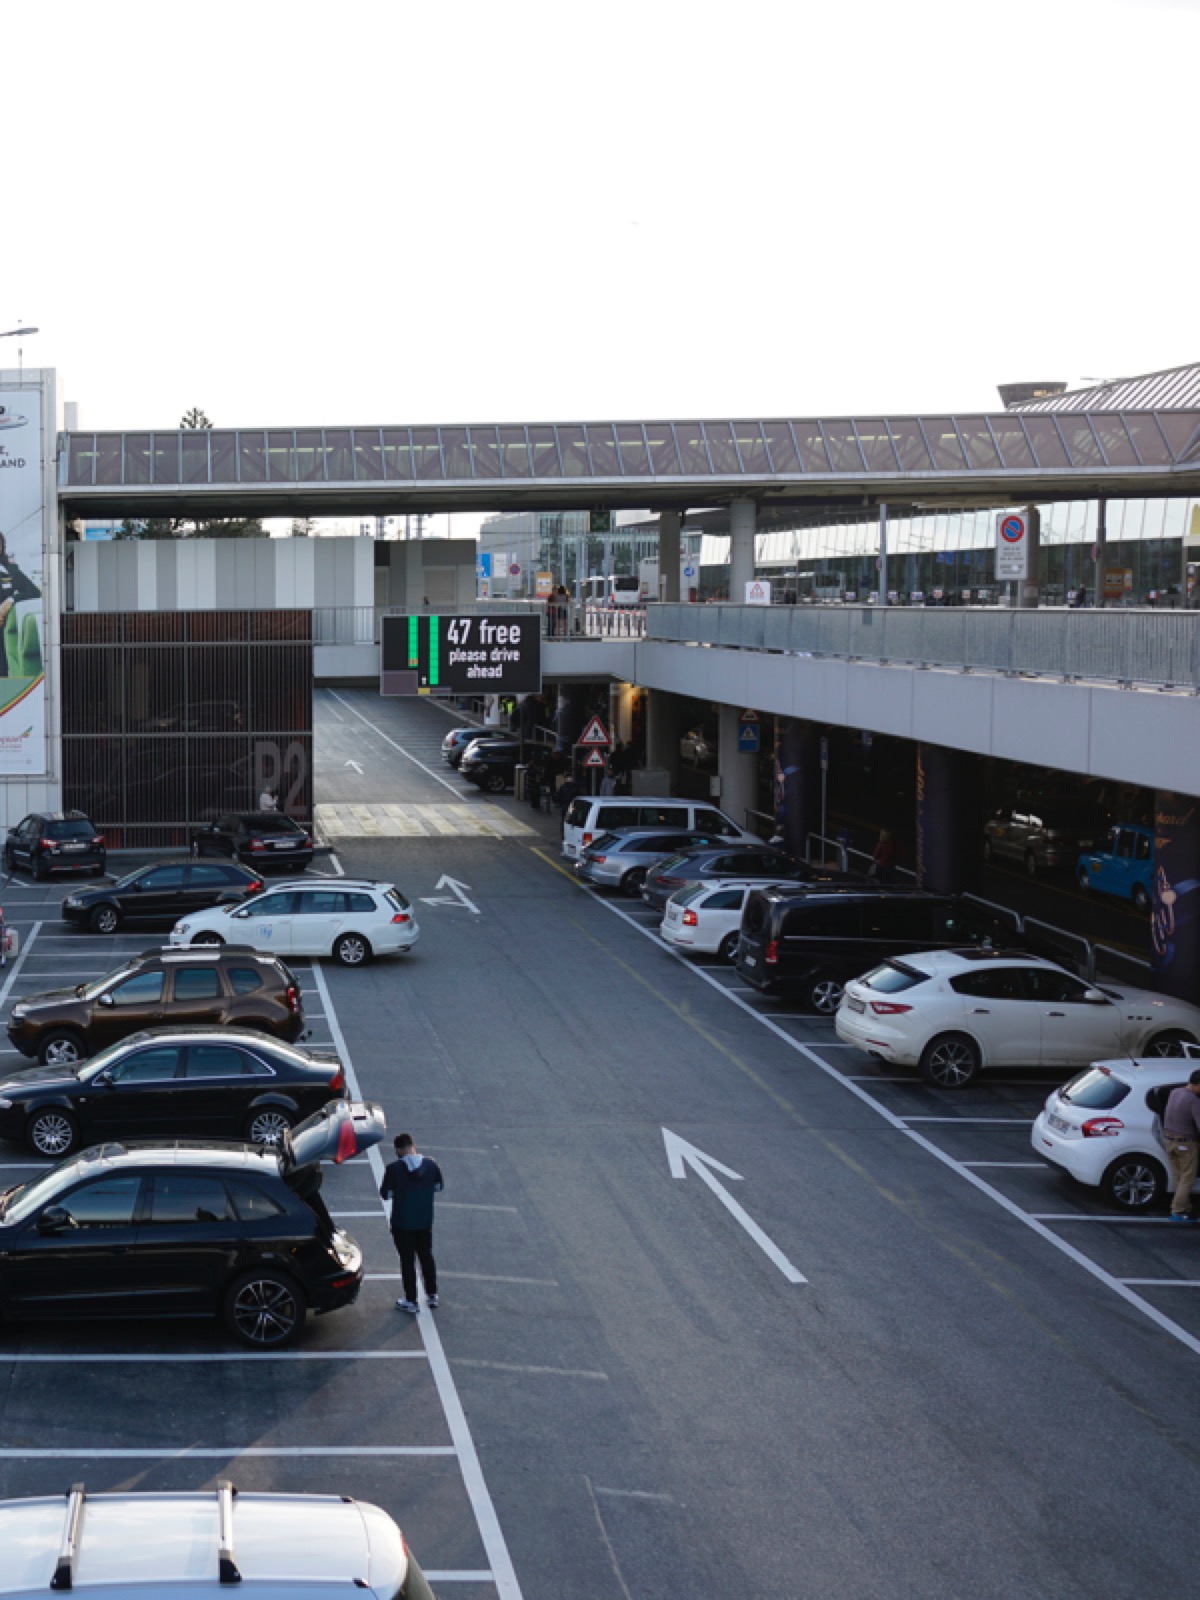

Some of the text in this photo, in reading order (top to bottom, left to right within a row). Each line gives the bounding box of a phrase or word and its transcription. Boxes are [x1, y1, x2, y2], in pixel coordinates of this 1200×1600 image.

[447, 618, 521, 644] 47 free
[449, 648, 521, 666] please drive
[467, 665, 503, 679] ahead
[254, 741, 308, 815] P2
